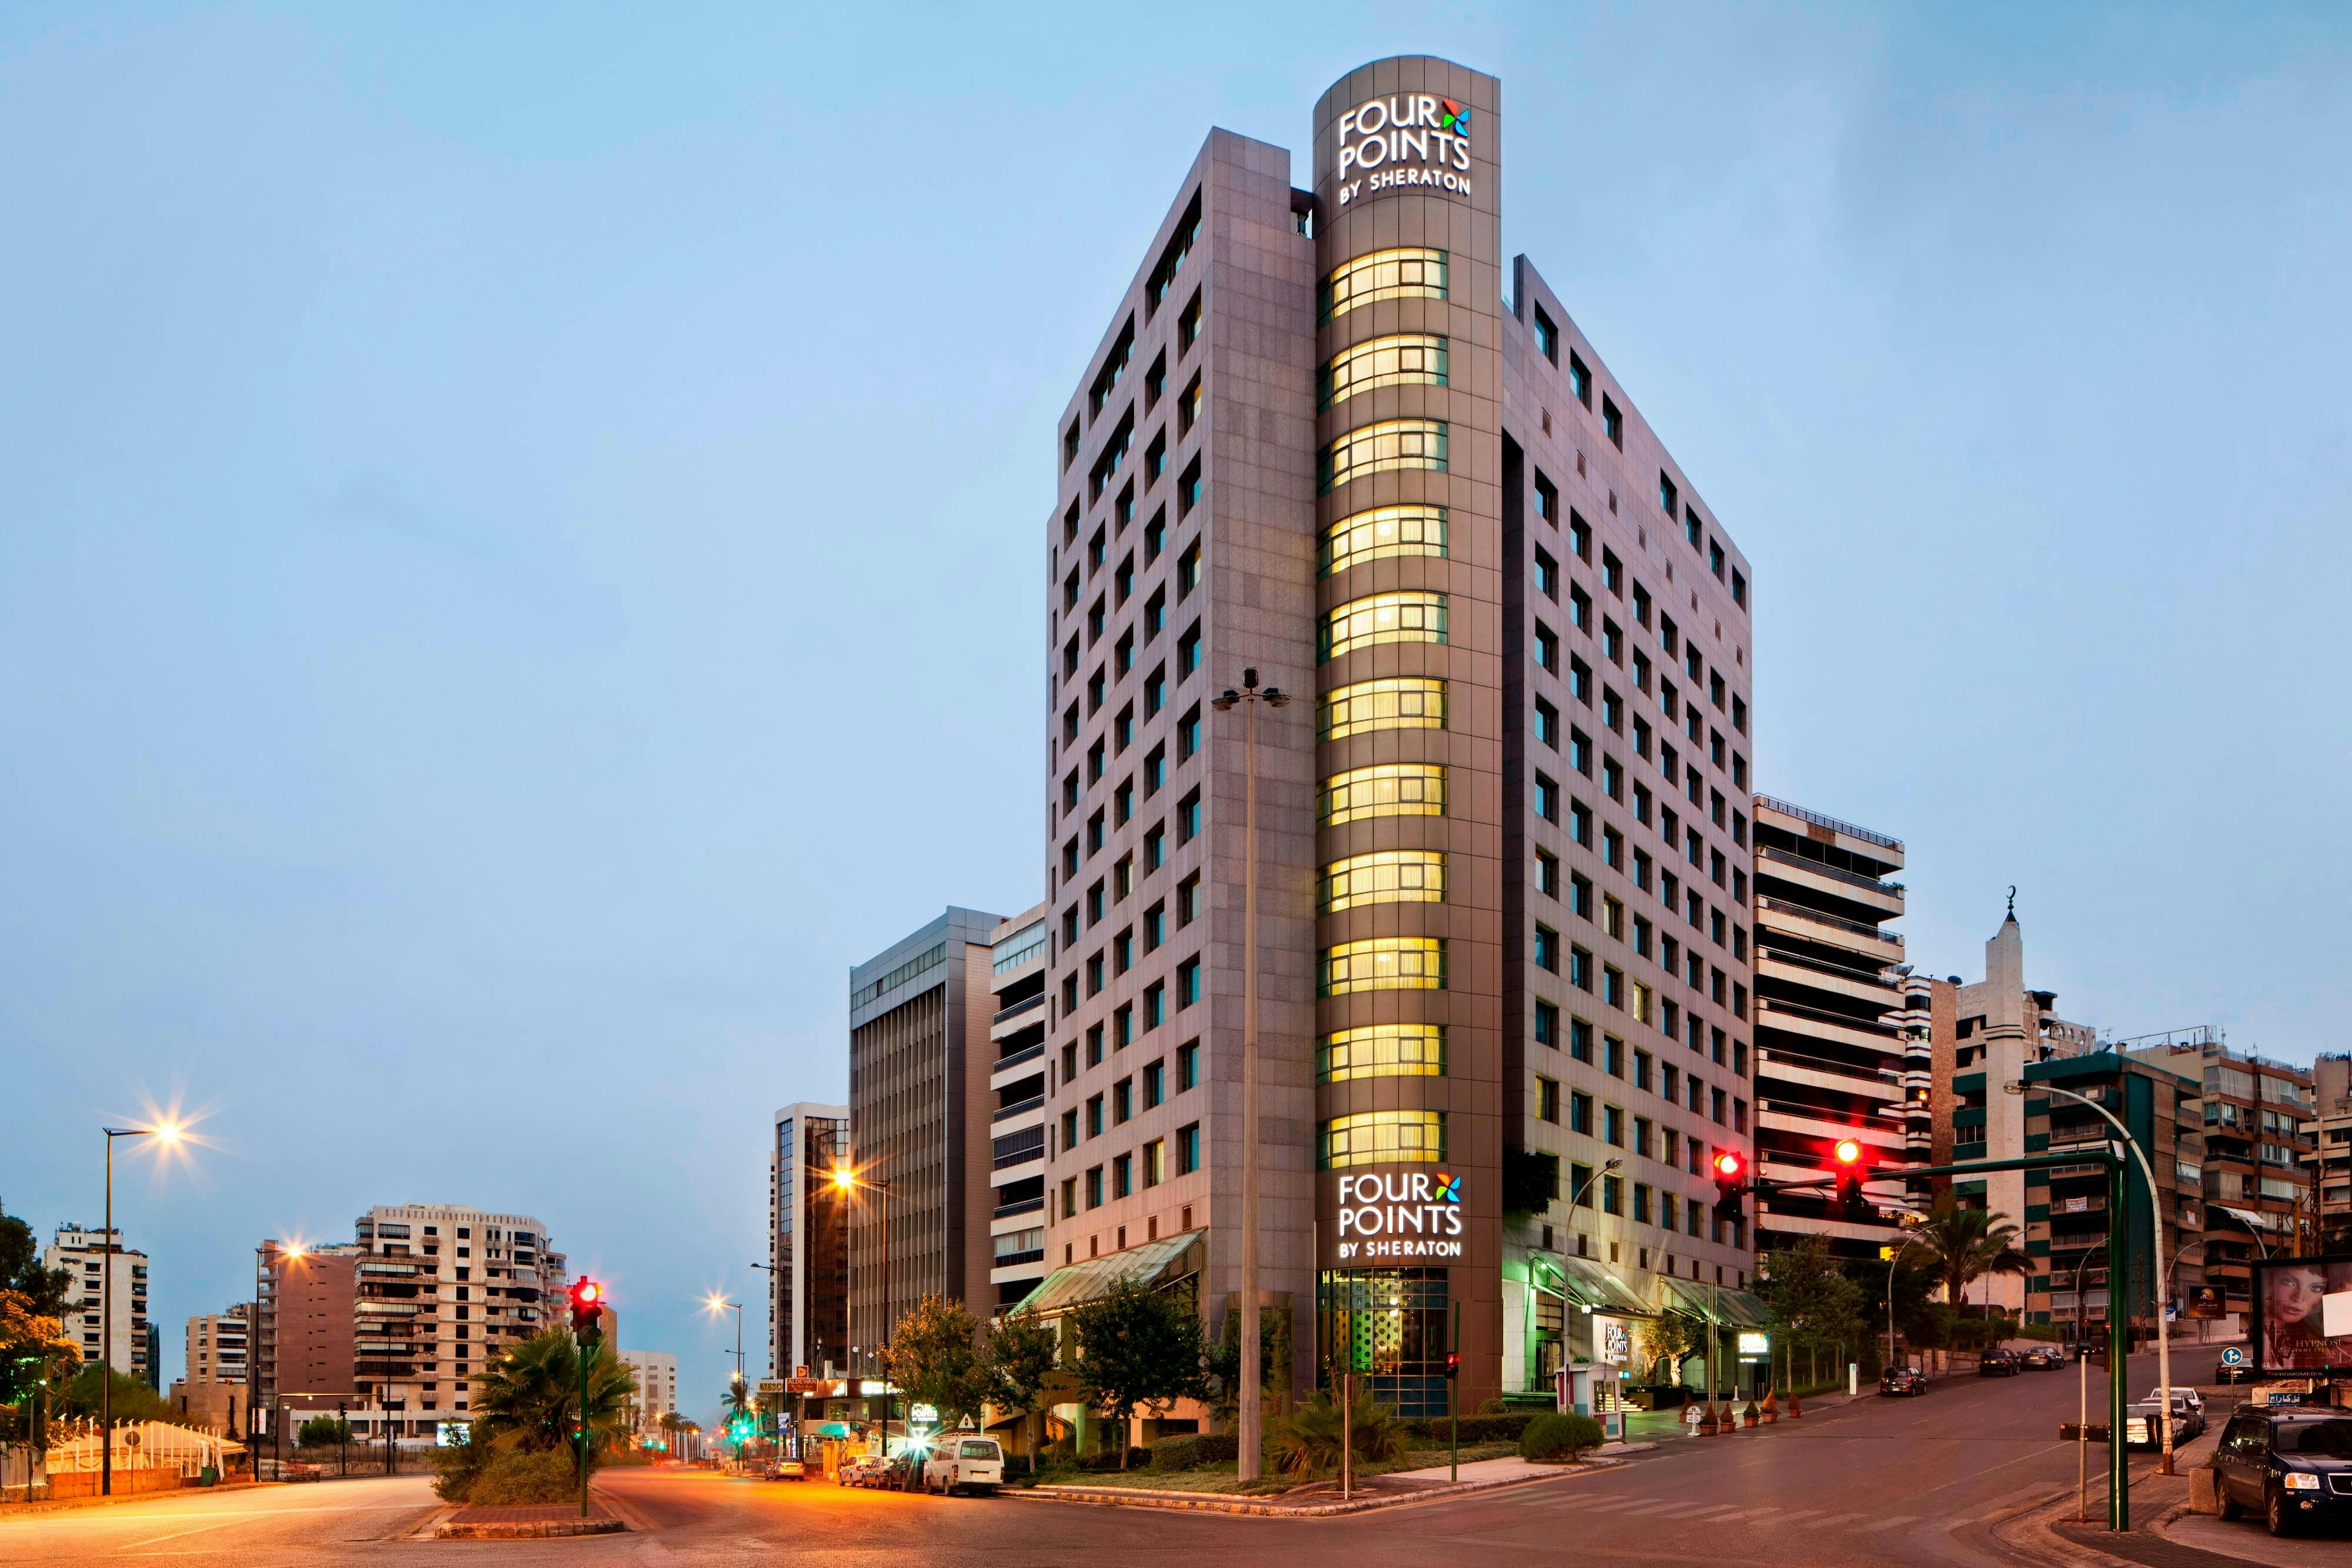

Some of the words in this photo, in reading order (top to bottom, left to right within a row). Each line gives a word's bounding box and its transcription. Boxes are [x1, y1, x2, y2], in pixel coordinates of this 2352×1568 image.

[1339, 95, 1442, 147] FOUR
[1339, 129, 1470, 181] POINTS
[1339, 179, 1362, 205] BY
[1369, 168, 1471, 196] SHERATON
[1339, 1173, 1433, 1205] FOUR
[1339, 1205, 1462, 1236] POINTS
[1339, 1243, 1359, 1258] BY
[1367, 1241, 1461, 1257] SHERATON
[1608, 1326, 1622, 1340] FOUR
[1608, 1340, 1628, 1353] POINTS
